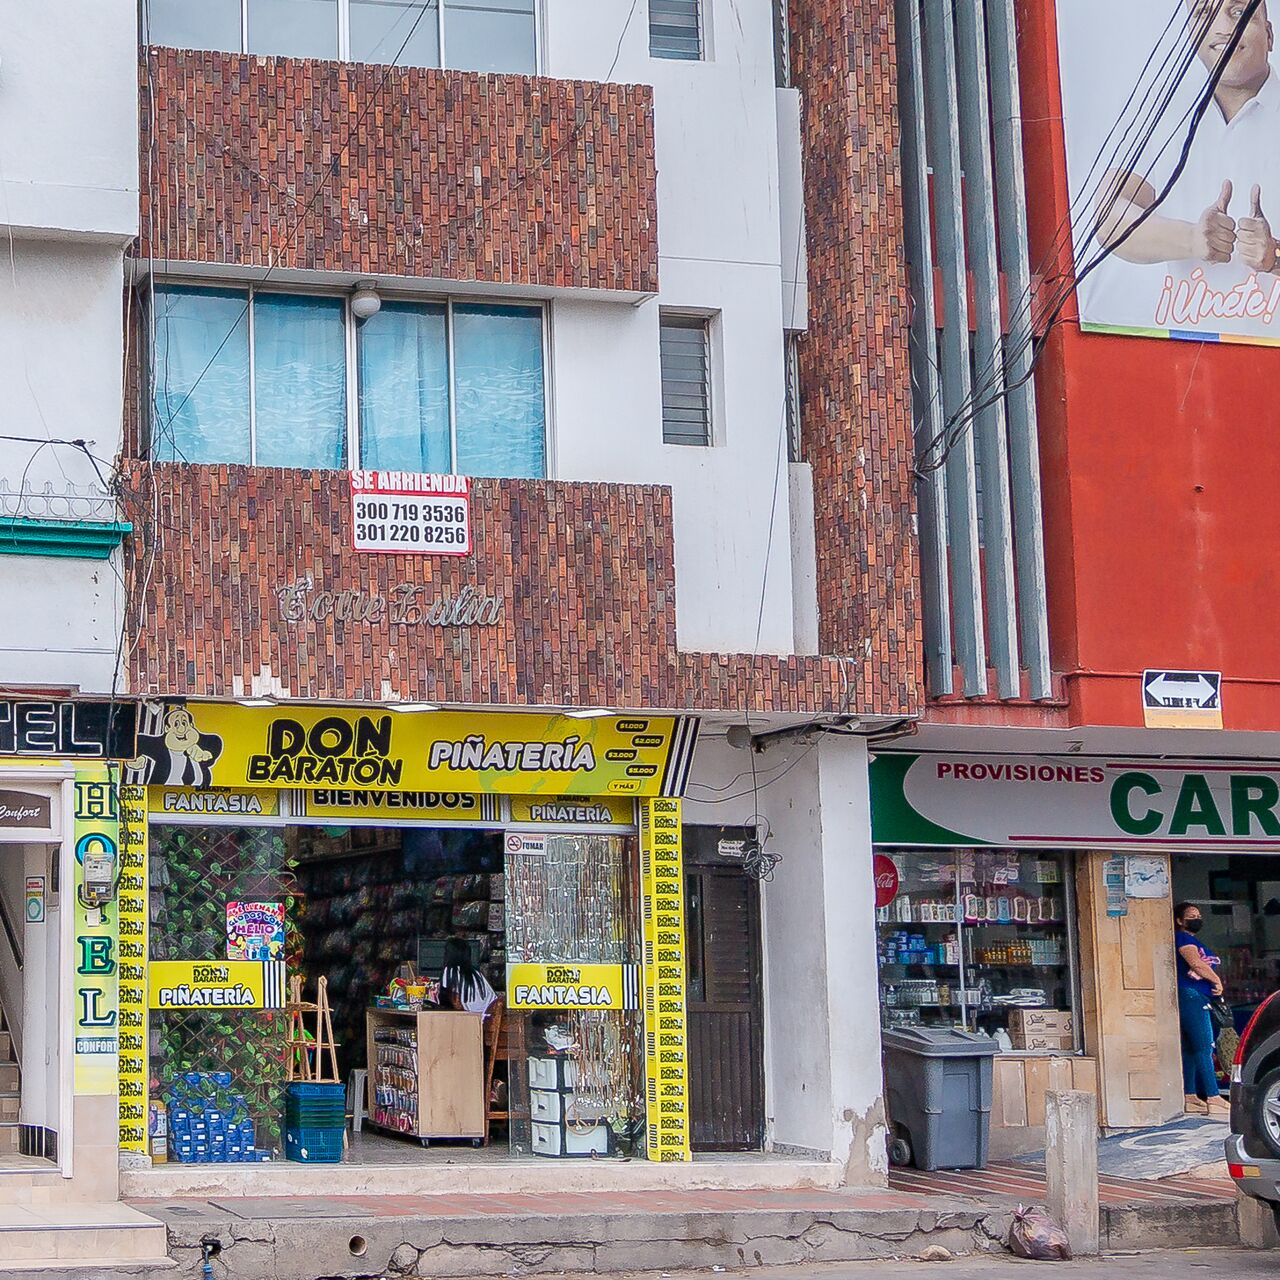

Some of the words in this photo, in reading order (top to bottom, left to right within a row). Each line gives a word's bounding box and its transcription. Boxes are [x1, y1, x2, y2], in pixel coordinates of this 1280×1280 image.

[351, 470, 374, 490] SE
[377, 471, 468, 494] ARRIENDA
[356, 502, 389, 520] 300
[392, 503, 419, 521] 719
[422, 504, 465, 523] 3536
[356, 523, 386, 541] 301
[390, 524, 420, 543] 220
[424, 526, 466, 544] 8256
[267, 715, 395, 761] DON
[427, 735, 596, 772] PIÑATERÍA
[245, 750, 405, 786] BARATÓN
[936, 762, 1105, 784] PROVISIONES
[164, 792, 262, 813] FANTASIA
[313, 789, 475, 811] BIENVENIDOS
[530, 801, 613, 822] PIÑATERÍA
[522, 842, 544, 851] FUMAR
[75, 781, 118, 1028] HOEL
[228, 911, 262, 928] GLOBOS
[159, 983, 255, 1007] PIÑATERÍA
[515, 985, 612, 1006] FANTASIA
[76, 1039, 118, 1054] CONFORT
